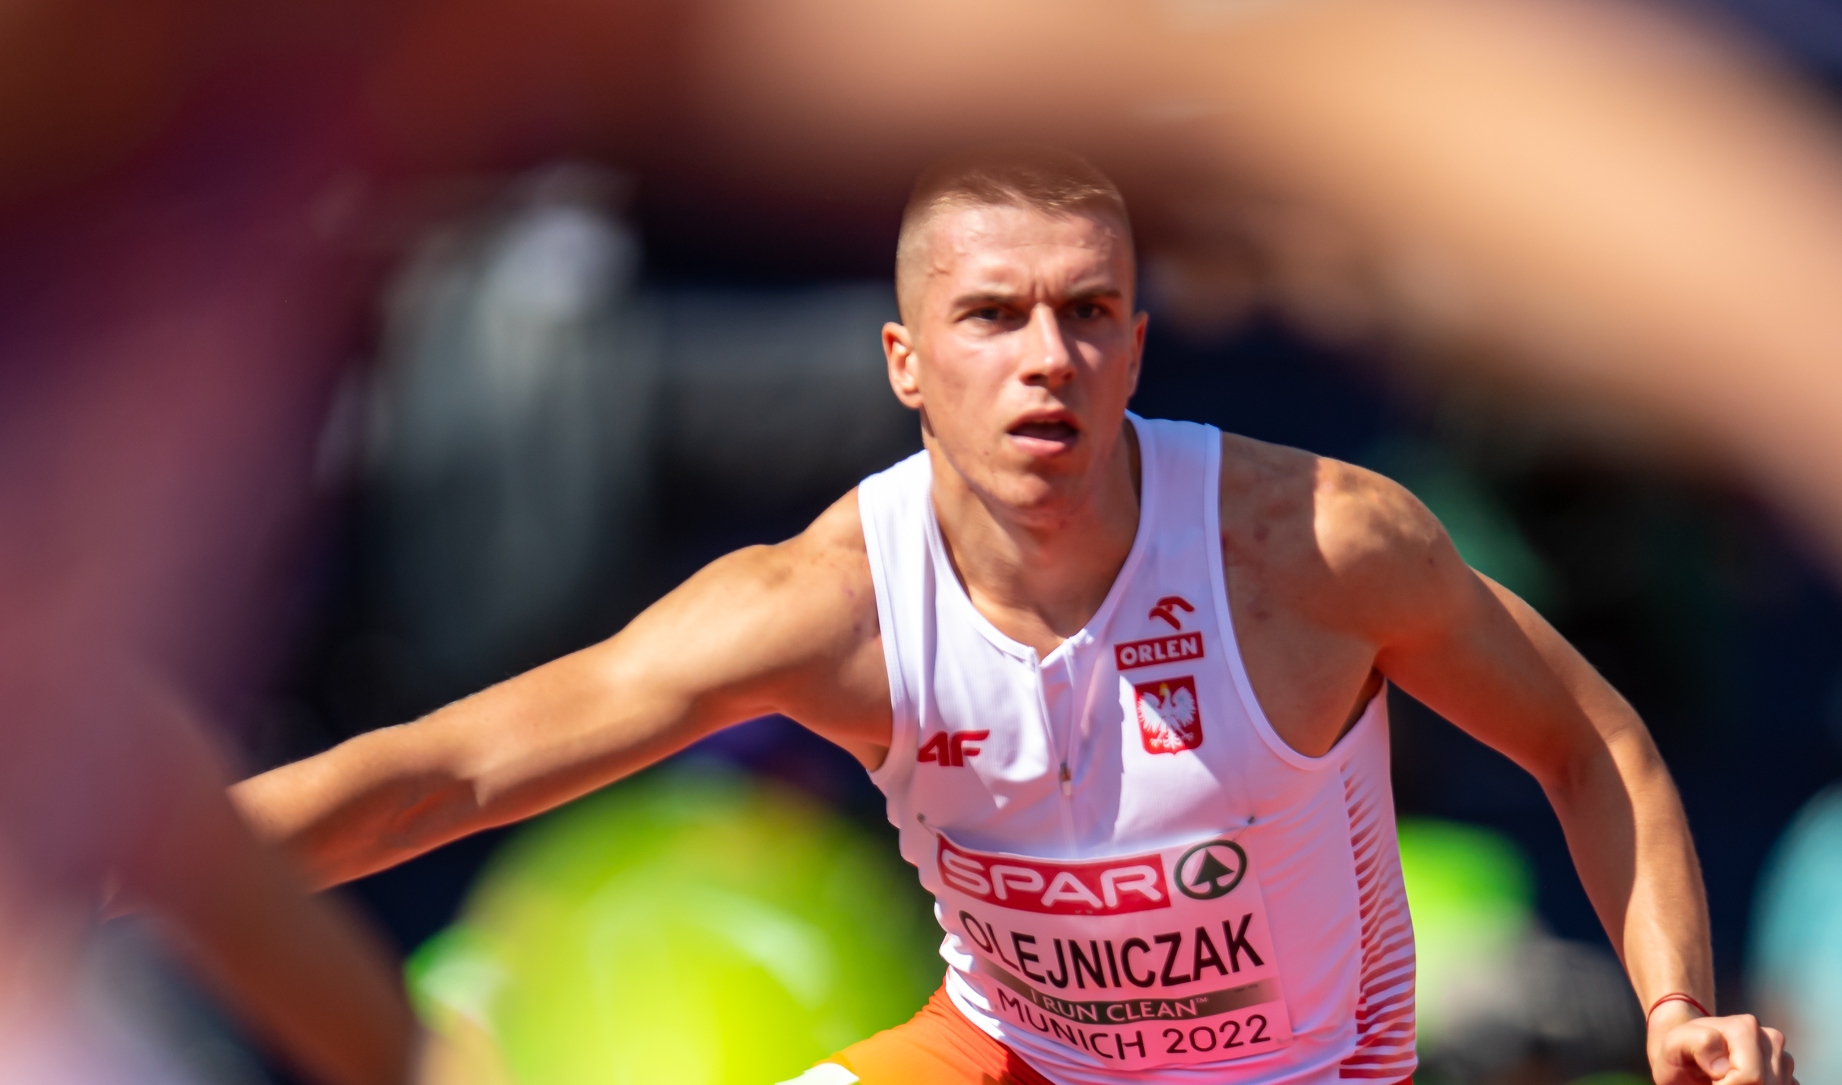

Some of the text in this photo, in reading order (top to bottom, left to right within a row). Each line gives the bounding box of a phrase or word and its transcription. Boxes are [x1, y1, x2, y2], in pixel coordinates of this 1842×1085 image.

[1119, 636, 1199, 666] ORLEN
[940, 849, 1163, 909] SPAR
[959, 909, 1265, 990] OLEJNICZAK
[996, 987, 1271, 1061] MUNICH 2022
[1043, 995, 1100, 1022] RUN
